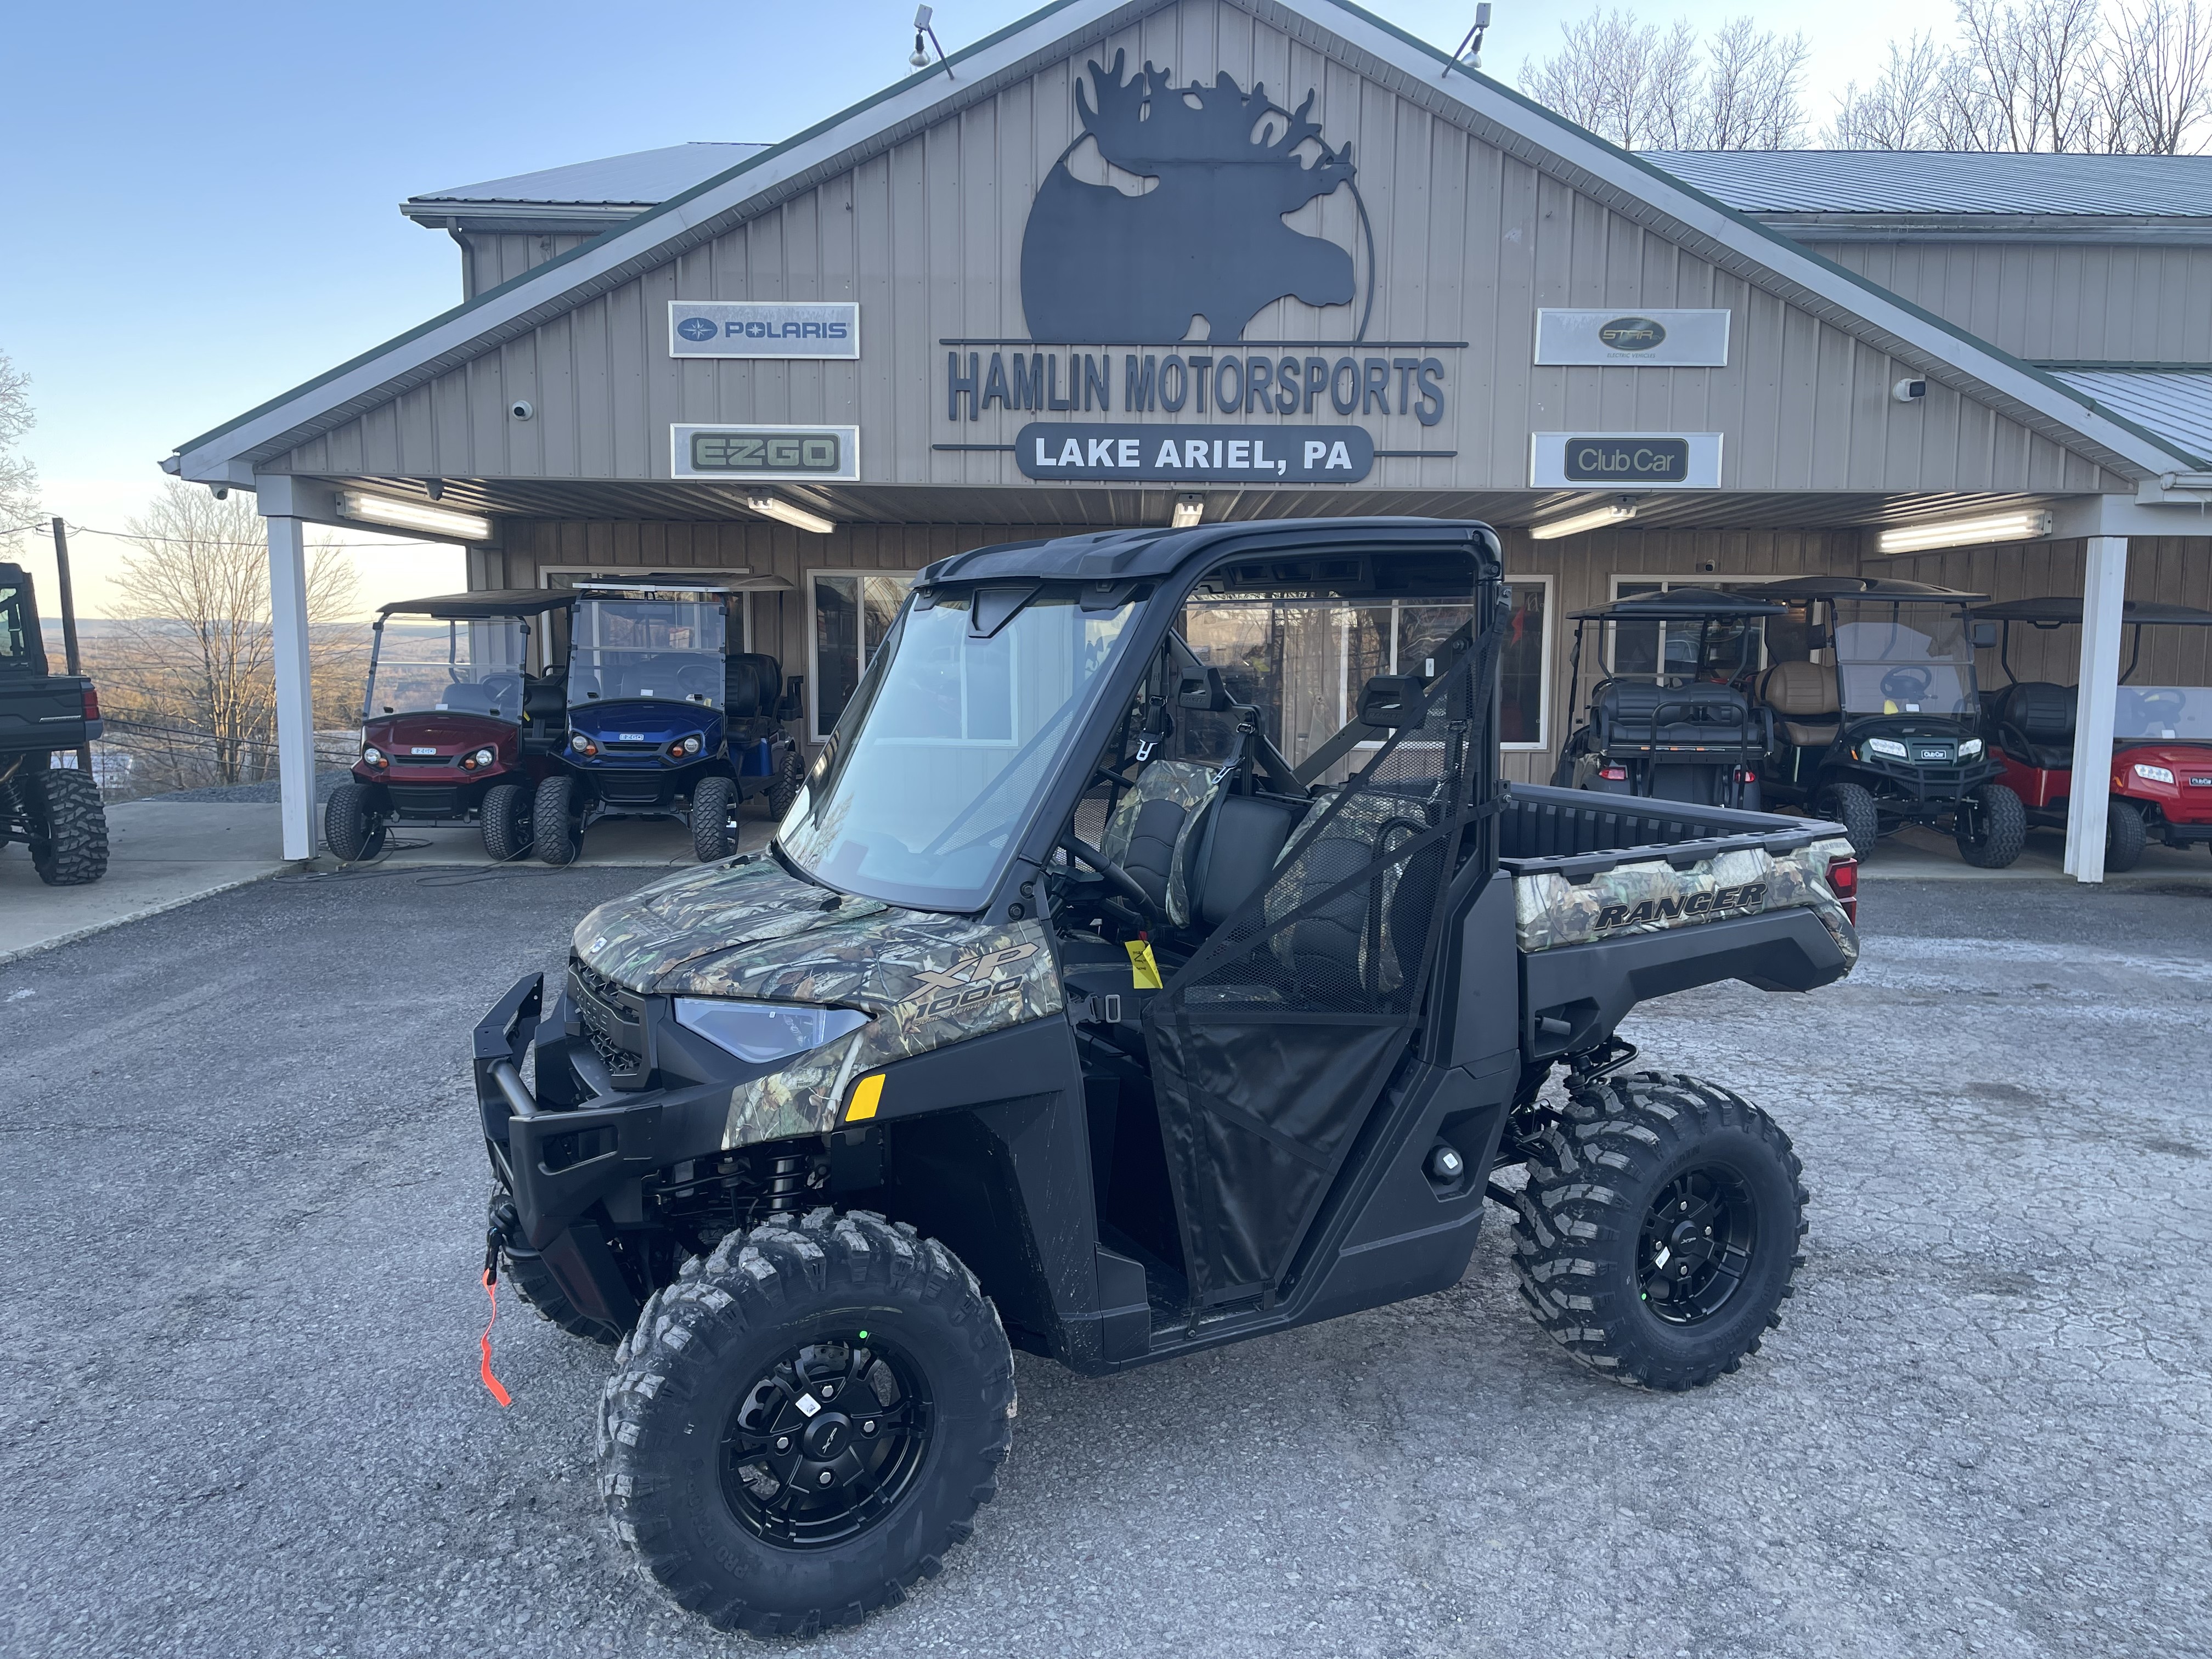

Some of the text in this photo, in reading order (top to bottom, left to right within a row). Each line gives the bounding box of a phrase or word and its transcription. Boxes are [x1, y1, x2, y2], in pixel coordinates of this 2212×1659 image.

[725, 321, 847, 338] POLARIS
[1602, 330, 1654, 340] STAR
[948, 351, 1444, 426] HAMLIN MOTORSPORTS
[696, 439, 835, 467] EZGO
[1036, 438, 1353, 476] LAKE ARIEL, PA
[1578, 448, 1675, 472] Club Car
[1594, 881, 1768, 930] RANGER
[895, 941, 1040, 1005] XP
[913, 974, 1024, 1020] 1000
[915, 1016, 941, 1027] DUAL
